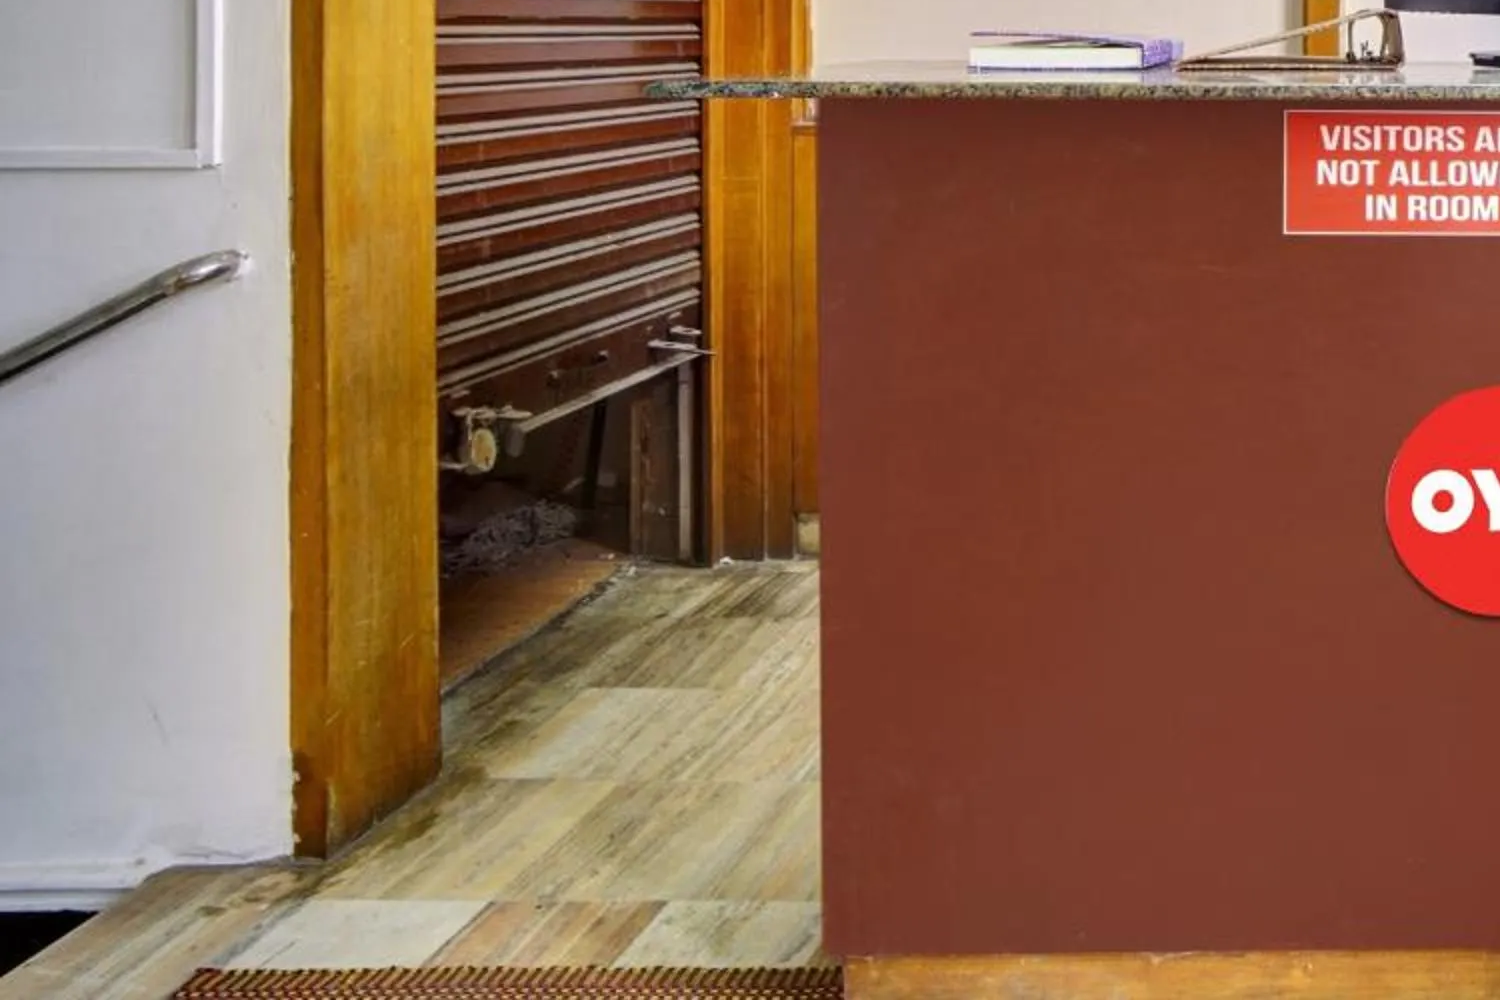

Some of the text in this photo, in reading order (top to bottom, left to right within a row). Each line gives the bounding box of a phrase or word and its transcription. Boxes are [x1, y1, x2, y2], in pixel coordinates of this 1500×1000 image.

[1320, 125, 1465, 151] VISITORS
[1316, 159, 1379, 185] NOT
[1365, 194, 1500, 221] IN ROOM
